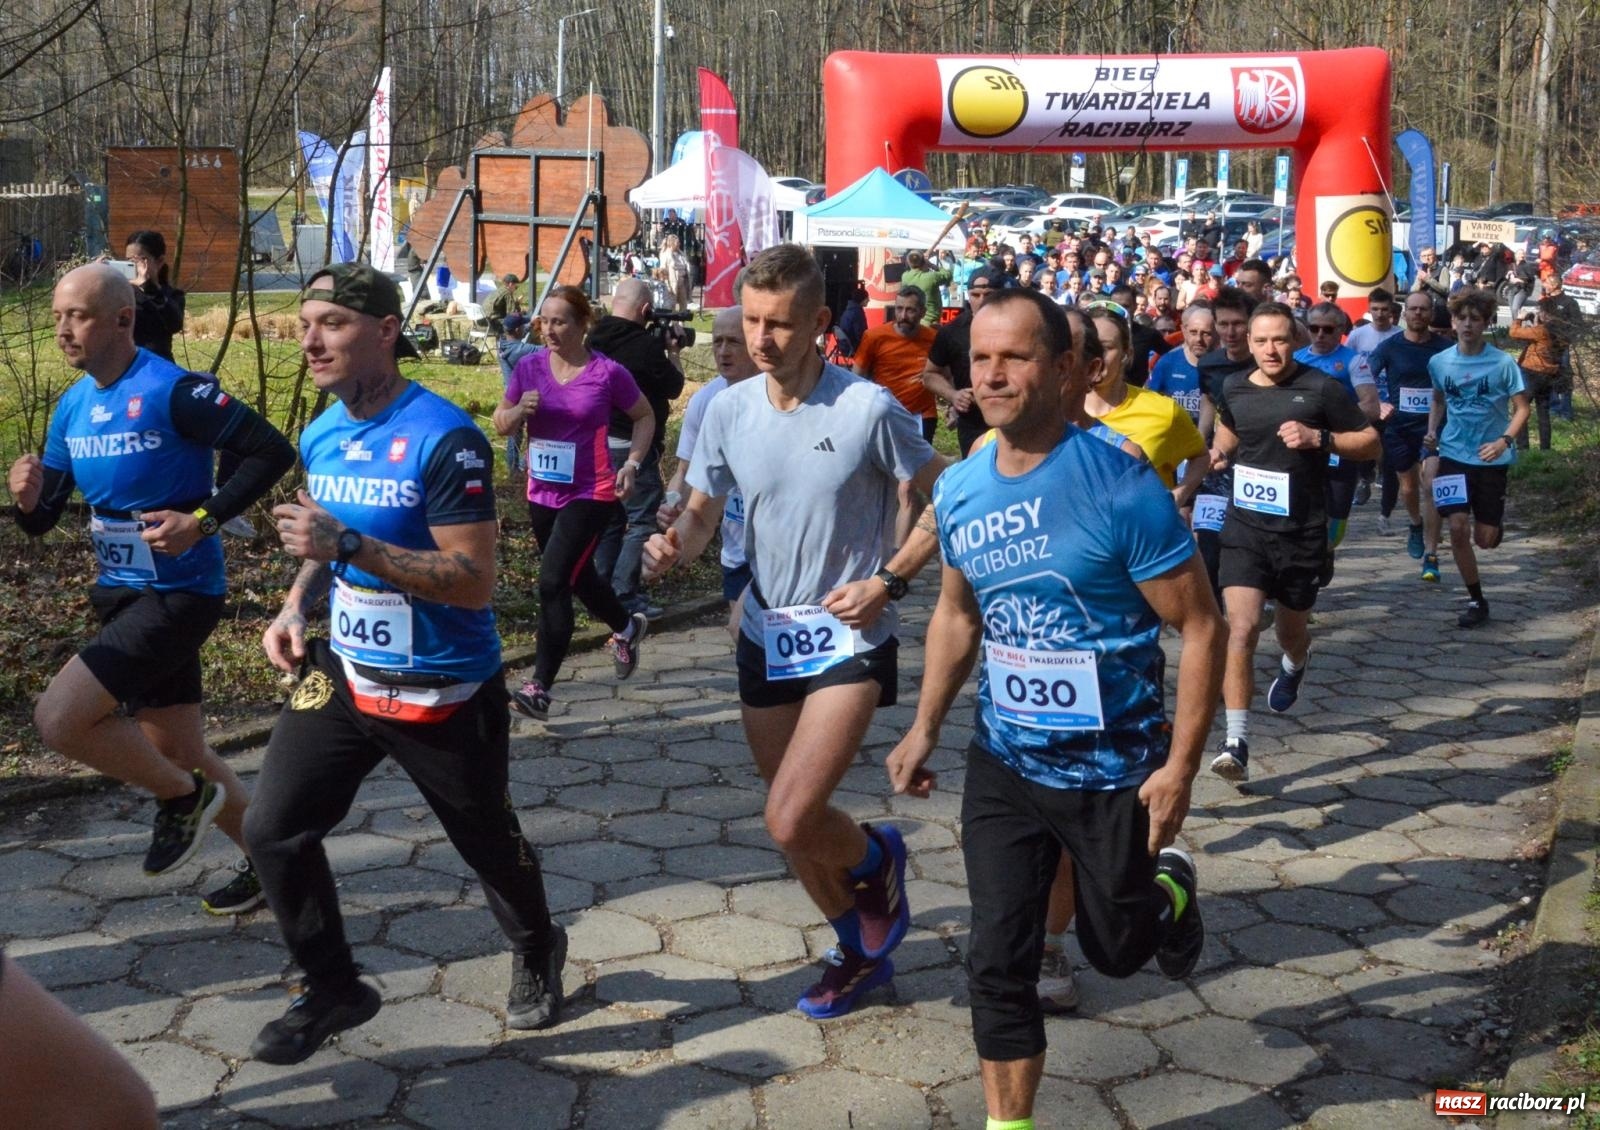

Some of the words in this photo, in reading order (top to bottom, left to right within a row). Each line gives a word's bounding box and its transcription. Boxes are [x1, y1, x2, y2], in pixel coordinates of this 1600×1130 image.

[1095, 67, 1156, 81] BIEG
[1045, 92, 1211, 110] TWARDZIELA
[1471, 222, 1502, 232] VAMOS
[1407, 396, 1428, 406] 104
[64, 429, 162, 459] UNNERS
[538, 453, 558, 470] 111
[307, 474, 421, 508] UNNERS
[1243, 482, 1277, 502] 029
[1436, 485, 1459, 499] 007
[1202, 507, 1227, 521] 123
[950, 497, 1042, 558] MORSY
[98, 540, 134, 565] 067
[961, 534, 1053, 582] ACIBÓRZ
[339, 610, 392, 647] 046
[777, 627, 836, 658] 082
[1028, 656, 1086, 666] TWARDZIELA
[1006, 674, 1077, 708] 030
